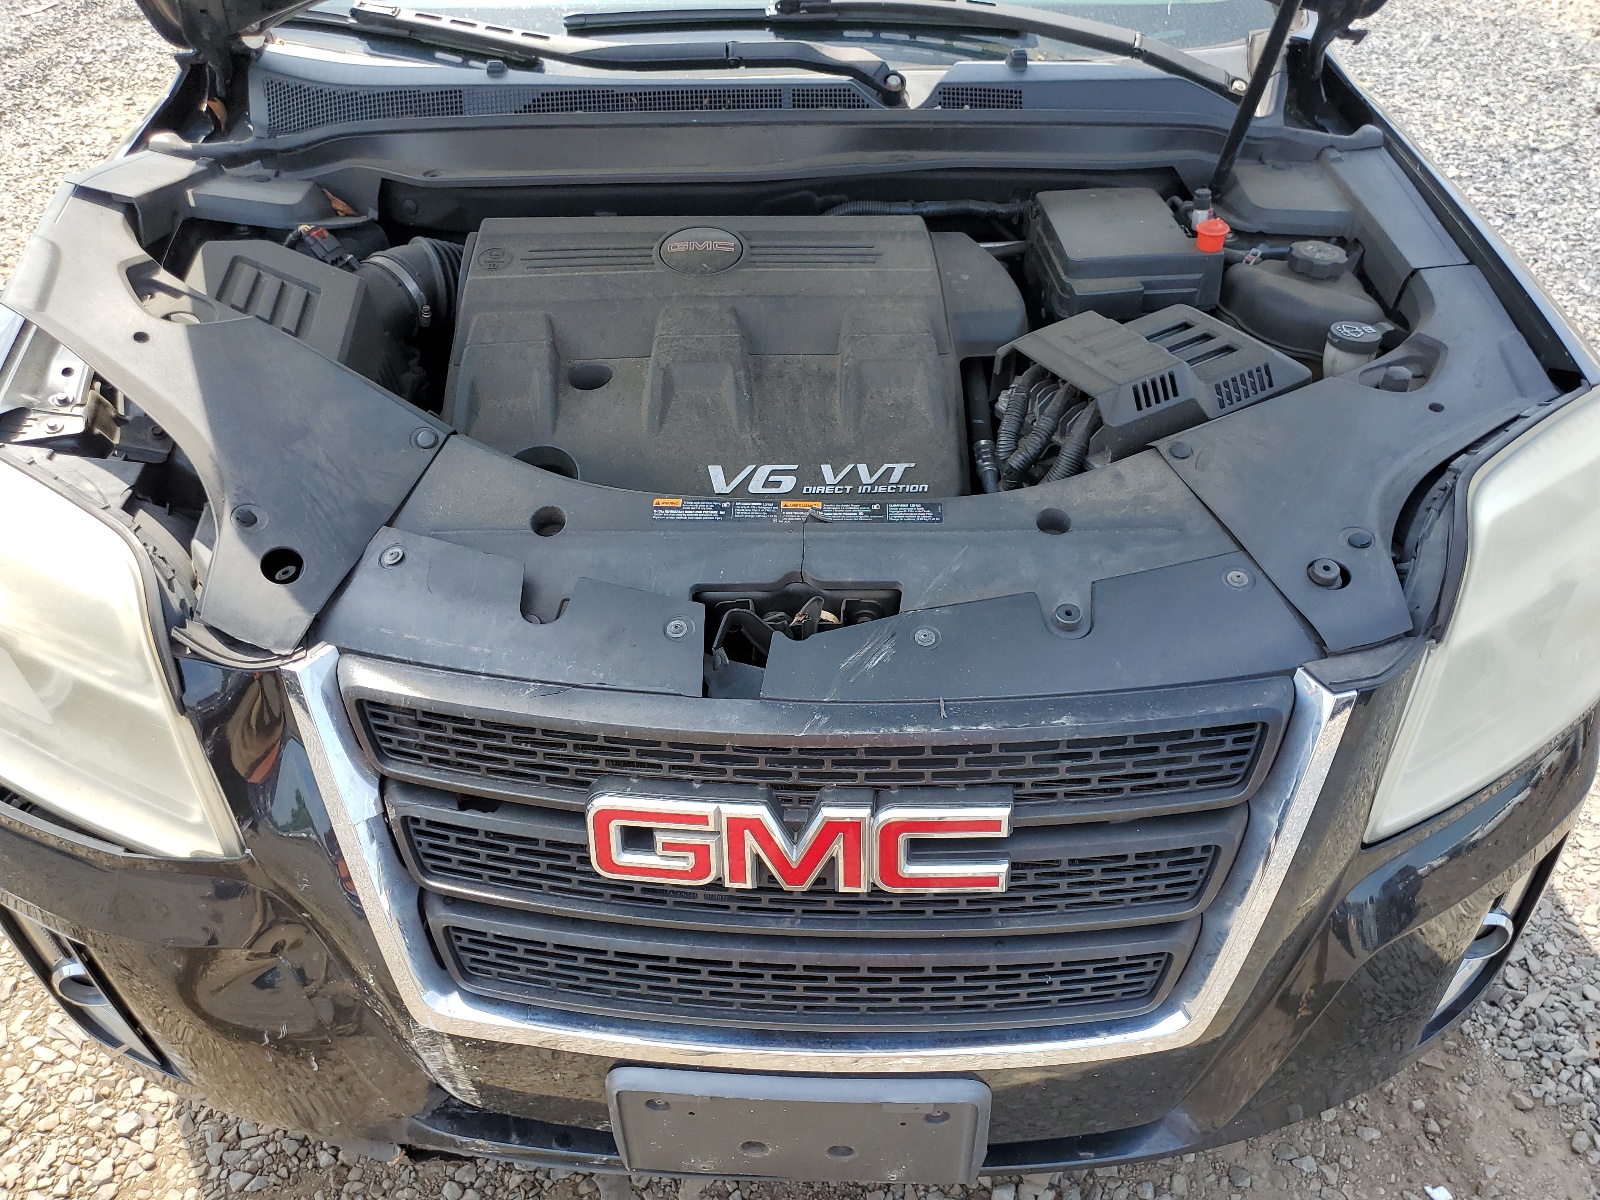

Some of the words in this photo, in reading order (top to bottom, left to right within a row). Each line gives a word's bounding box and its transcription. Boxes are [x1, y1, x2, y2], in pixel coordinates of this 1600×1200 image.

[667, 240, 735, 253] GMC
[707, 464, 799, 494] V6
[820, 462, 917, 485] VVT
[802, 485, 853, 494] DIRECT
[857, 483, 929, 493] INJECTION
[586, 790, 1013, 894] GMC
